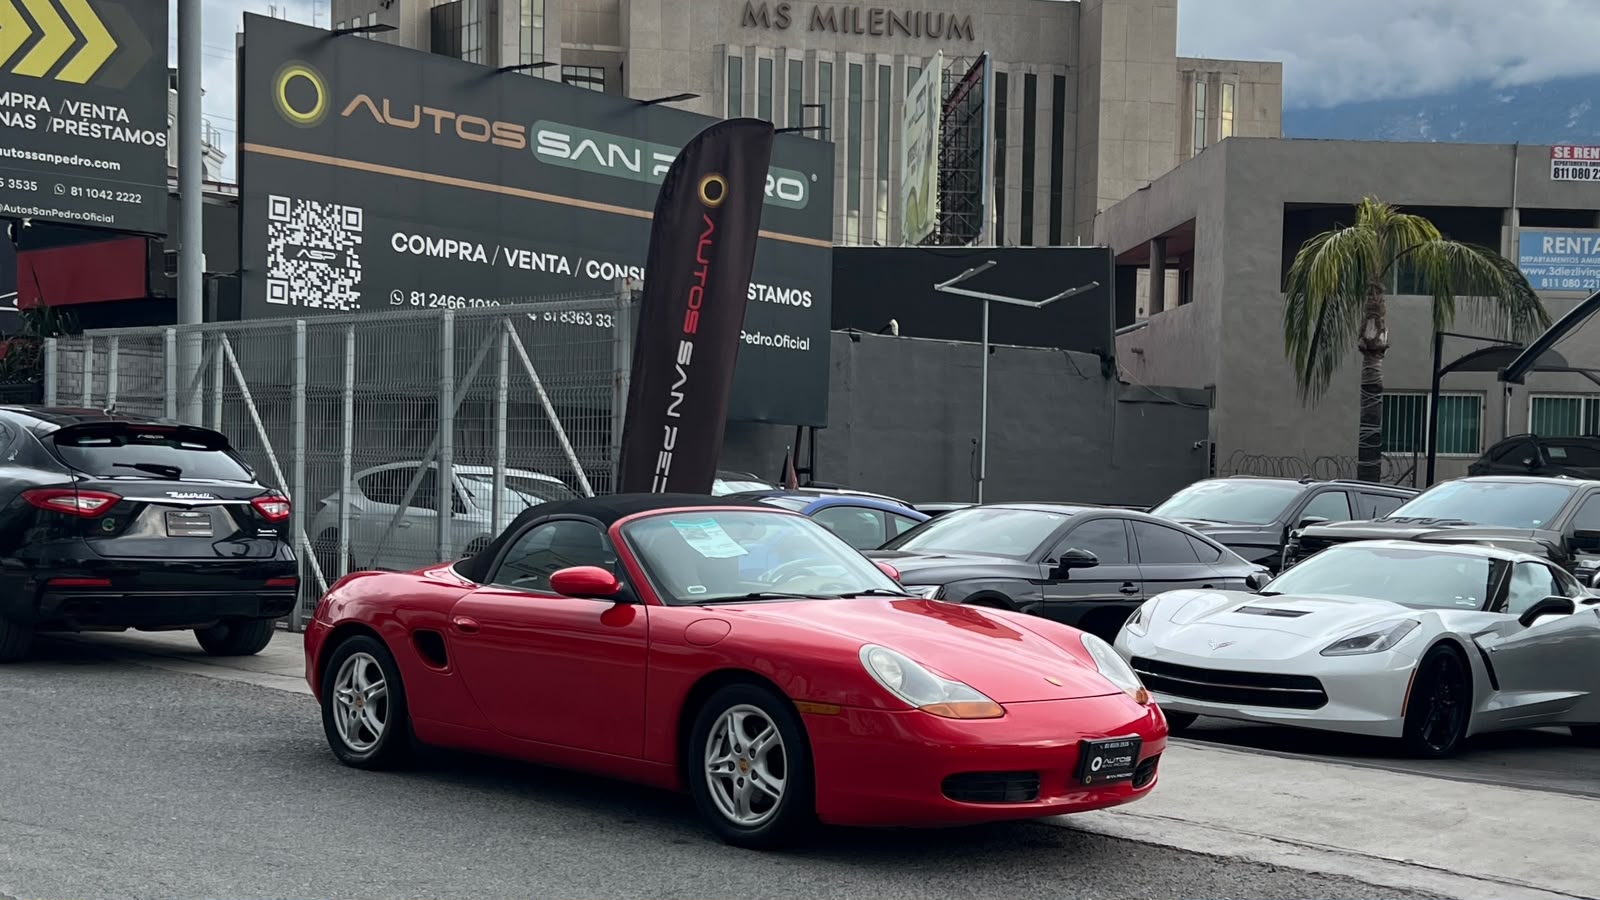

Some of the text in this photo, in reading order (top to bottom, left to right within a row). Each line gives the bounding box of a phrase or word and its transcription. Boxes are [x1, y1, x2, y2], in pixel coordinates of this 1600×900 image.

[742, 2, 975, 41] MS MILENIUM
[341, 94, 527, 150] AUTOS
[537, 129, 641, 173] SAN
[1554, 146, 1571, 159] SE
[1553, 167, 1600, 180] 811 080 2
[8, 178, 38, 191] 3535
[70, 186, 83, 197] 81
[86, 188, 113, 200] 1042
[116, 192, 142, 204] 2222
[391, 232, 488, 264] COMPRA
[504, 247, 571, 275] VENTA
[1542, 278, 1559, 288] 811
[1562, 278, 1581, 288] 080
[410, 291, 425, 306] 81
[429, 293, 466, 309] 2466
[651, 213, 715, 494] AUTOS SAN PED
